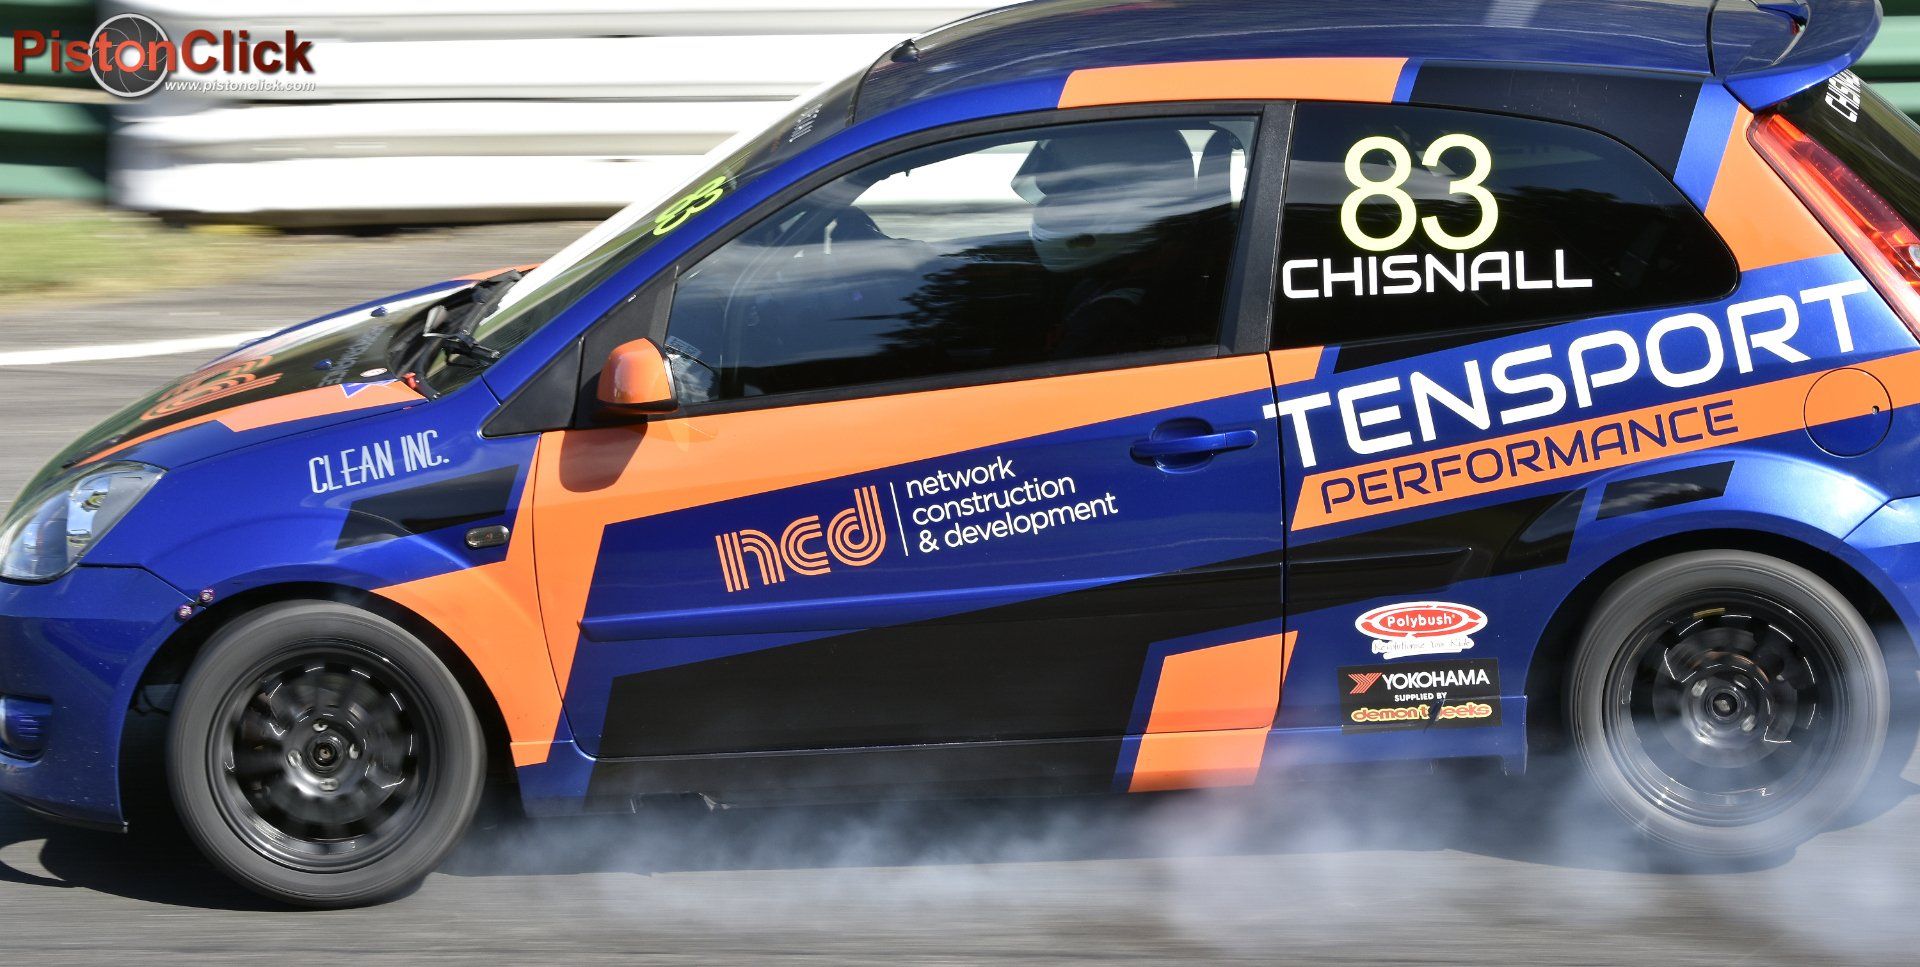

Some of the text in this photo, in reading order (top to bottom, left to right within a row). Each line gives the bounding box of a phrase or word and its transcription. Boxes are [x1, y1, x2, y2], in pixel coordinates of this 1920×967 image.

[1340, 133, 1499, 252] 83
[1282, 249, 1593, 299] CHISNALL
[1262, 279, 1868, 469] TENSPORT
[308, 429, 450, 494] CLEAN INC.
[905, 455, 1016, 499] network
[1320, 399, 1739, 514] PERFORMANCE
[912, 473, 1076, 526] construction
[918, 492, 1119, 554] & development
[715, 484, 887, 592] ncd
[1387, 613, 1453, 628] Polybush
[1382, 668, 1491, 690] YOKOHAMA
[1394, 692, 1448, 702] SUPPLIED BY
[1351, 702, 1492, 722] demon teeks
